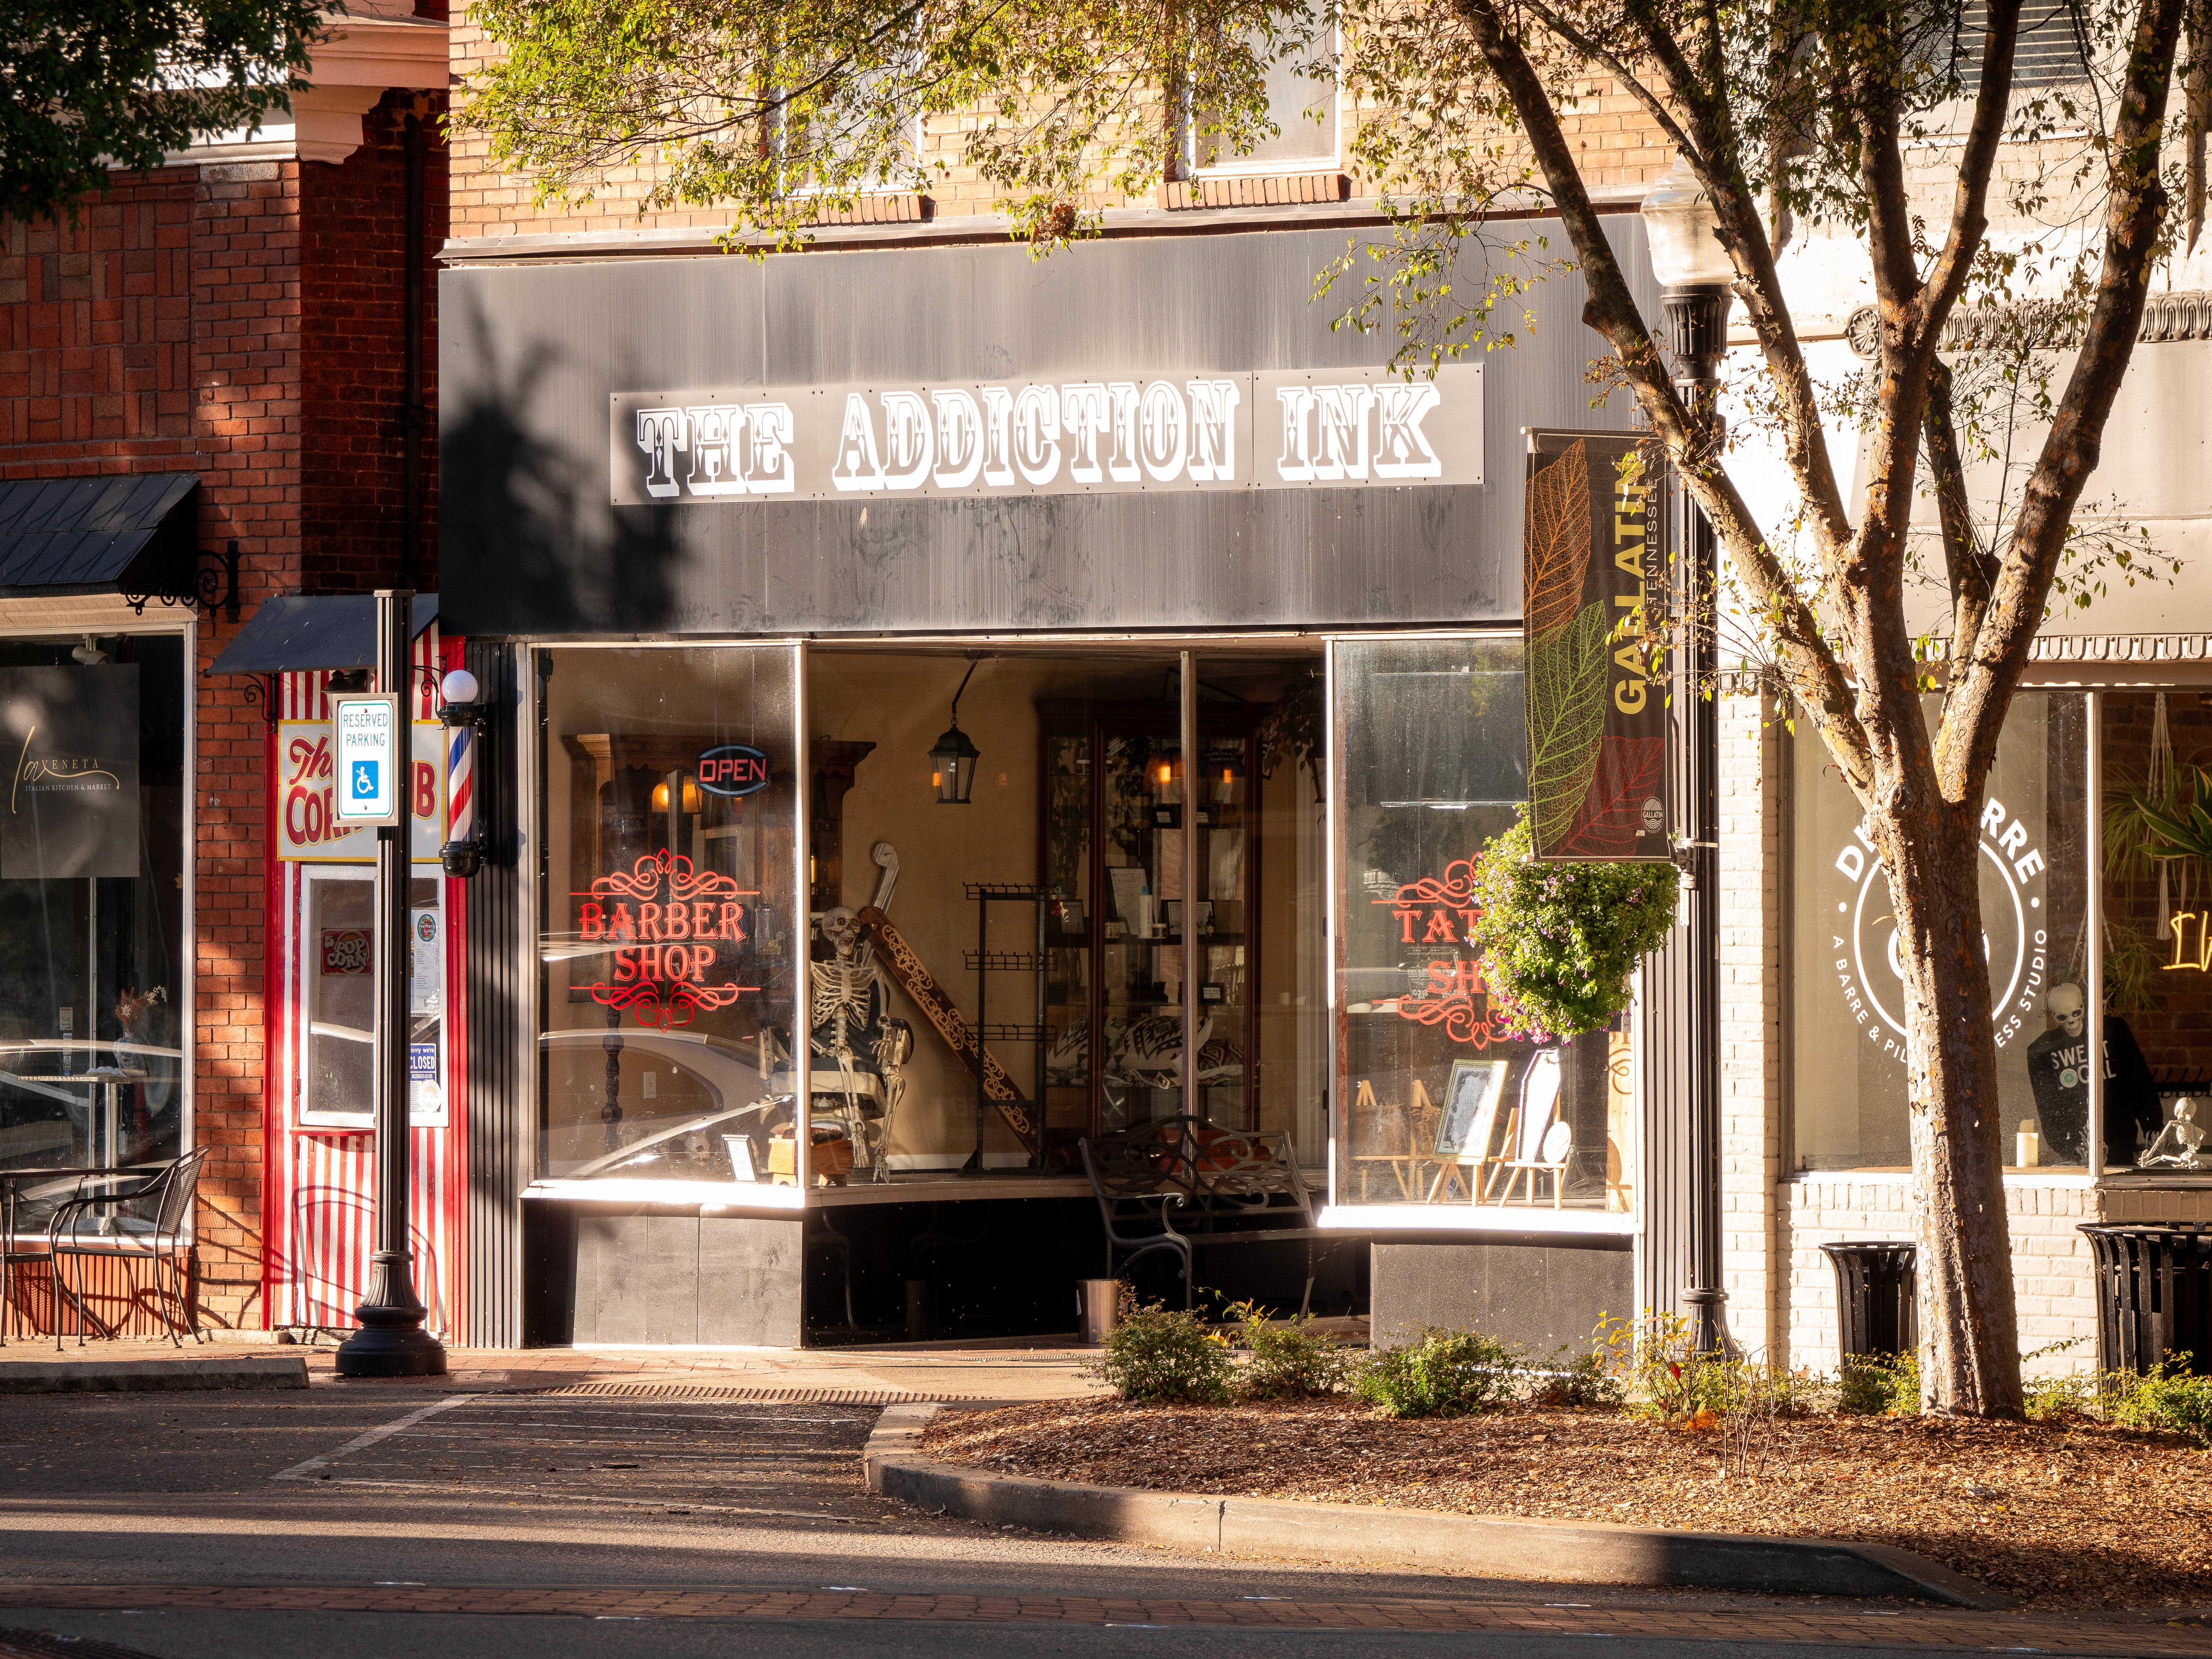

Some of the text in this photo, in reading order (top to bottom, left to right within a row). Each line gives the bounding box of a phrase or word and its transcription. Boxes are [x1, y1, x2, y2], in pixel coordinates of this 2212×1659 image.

[637, 380, 1441, 498] THE ADDICTION INK
[1646, 478, 1657, 604] TENNESSEE
[1615, 462, 1646, 714] GALLATIN
[344, 714, 388, 727] RESERVED
[347, 733, 385, 746] PARKING
[42, 759, 98, 769] VENETA
[288, 734, 333, 786] Th
[700, 759, 766, 781] OPEN
[1644, 825, 1663, 834] TENNESSEE
[1981, 797, 2045, 884] RRE
[579, 902, 746, 943] BARBER
[1392, 910, 1486, 943] TAT
[327, 952, 368, 968] CORN
[335, 937, 365, 954] POP
[614, 945, 715, 981] SHOP
[1426, 961, 1485, 994] SH
[2020, 930, 2046, 1011] STUDIO
[1833, 935, 1879, 1042] A BARRE &
[2051, 1040, 2108, 1069] SWET
